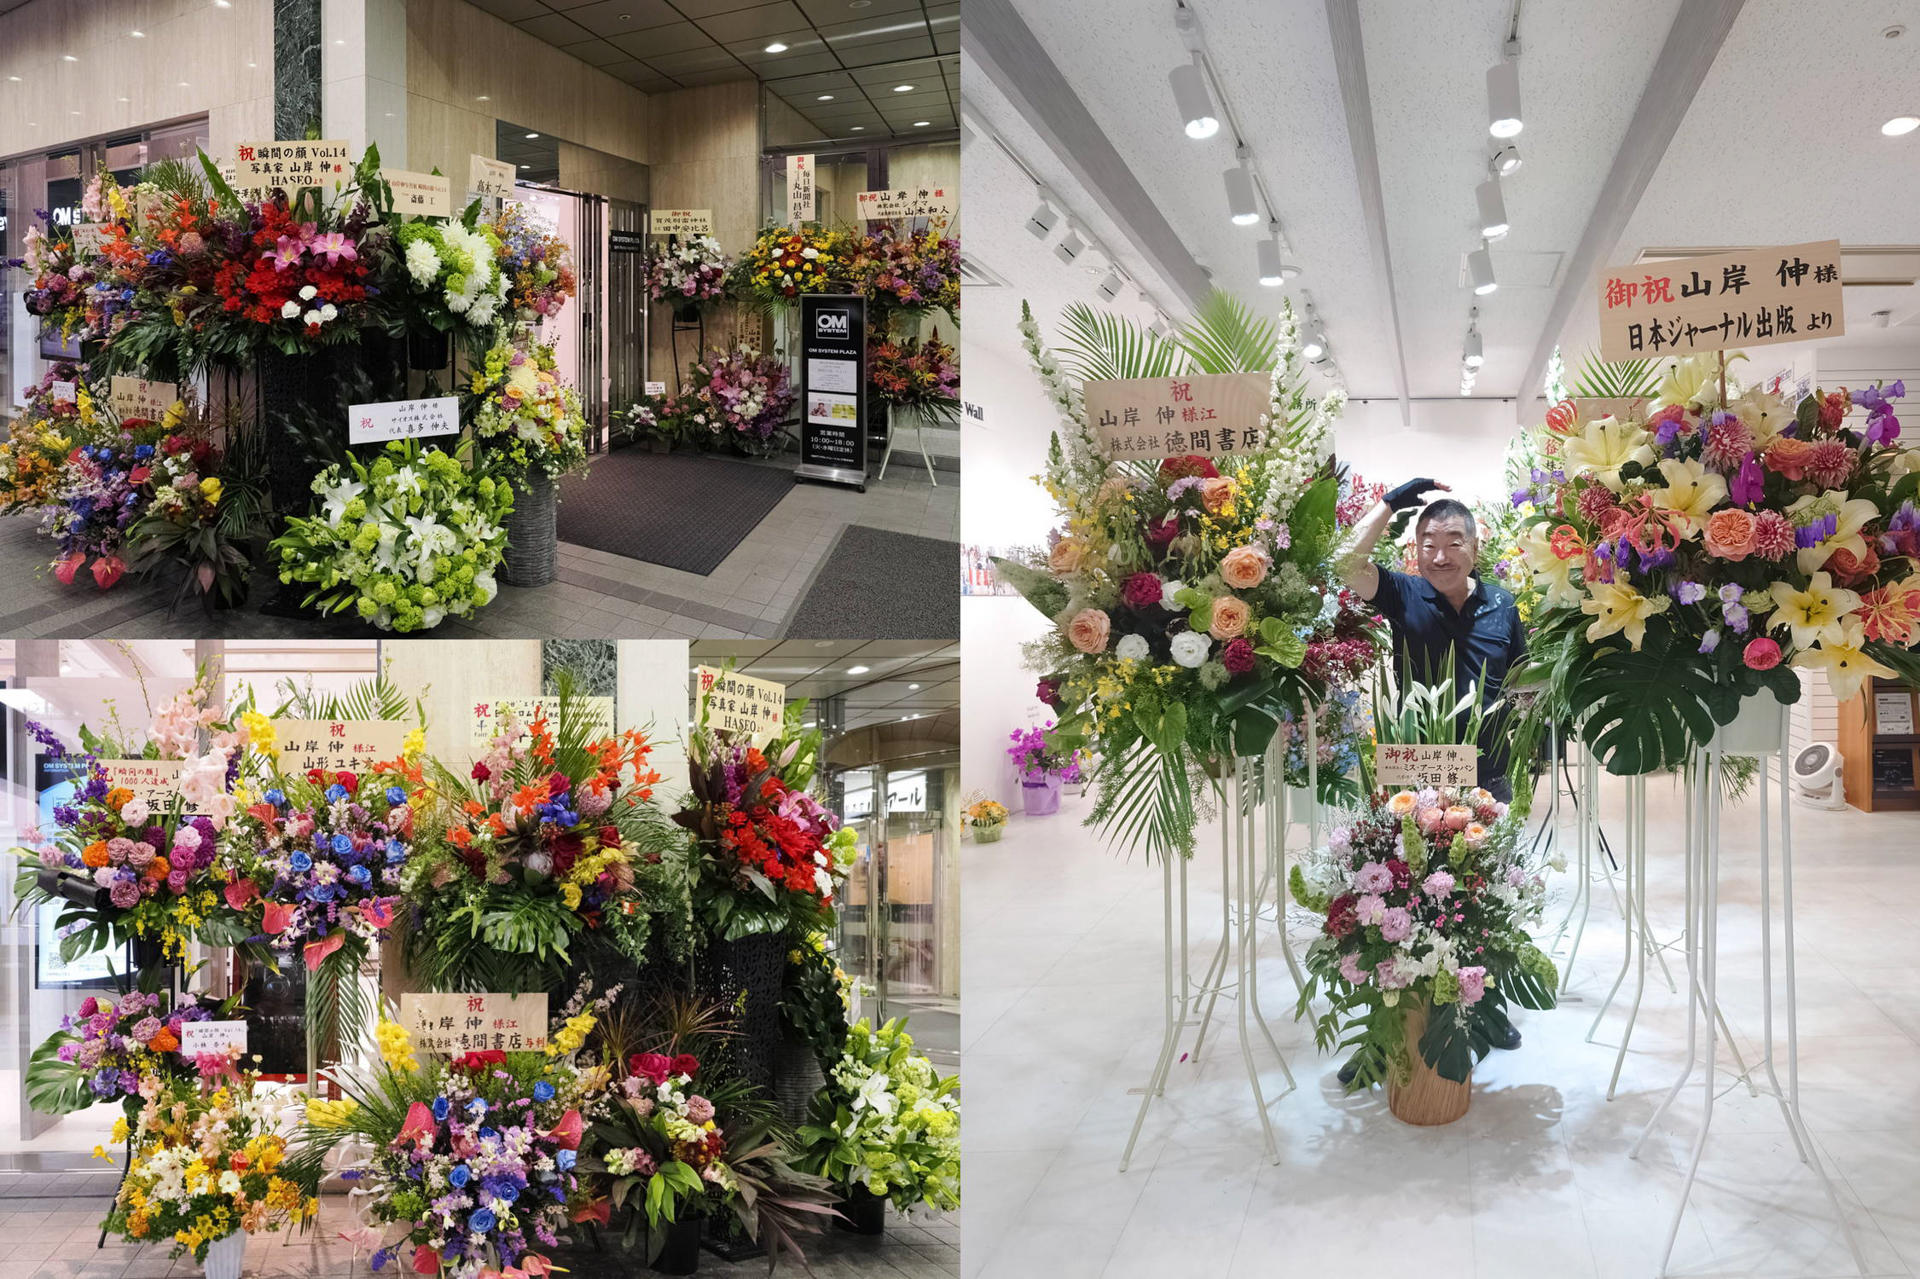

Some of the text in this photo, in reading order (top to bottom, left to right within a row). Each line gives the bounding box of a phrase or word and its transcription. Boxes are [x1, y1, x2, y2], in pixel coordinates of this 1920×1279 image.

[238, 145, 346, 161] 祝 瞬間の顔 Vol.14
[251, 163, 283, 174] 写真家
[271, 176, 312, 186] HASEO
[1605, 275, 1675, 309] 御祝
[1681, 264, 1751, 298] 山岸
[818, 314, 847, 328] OM
[1628, 304, 1833, 352] 日本ジャーナル出版 より
[1170, 380, 1193, 402] 祝
[964, 401, 984, 421] Wall
[1100, 408, 1141, 427] 山岸
[361, 418, 374, 429] 祝
[1110, 427, 1260, 454] 株式会社 徳間書店
[701, 670, 782, 705] 祝 瞬間の顔 Vol.14
[473, 703, 491, 718] 祝
[709, 696, 736, 712] 写真家
[330, 722, 346, 738] 祝
[724, 716, 756, 732] HASEO
[284, 740, 319, 753] 山岸
[303, 756, 328, 770] 山形
[1385, 747, 1418, 763] 御祝
[1421, 750, 1442, 761] 山岸
[1404, 764, 1475, 772] ミス・アース・ジャパン
[466, 996, 485, 1012] 祝
